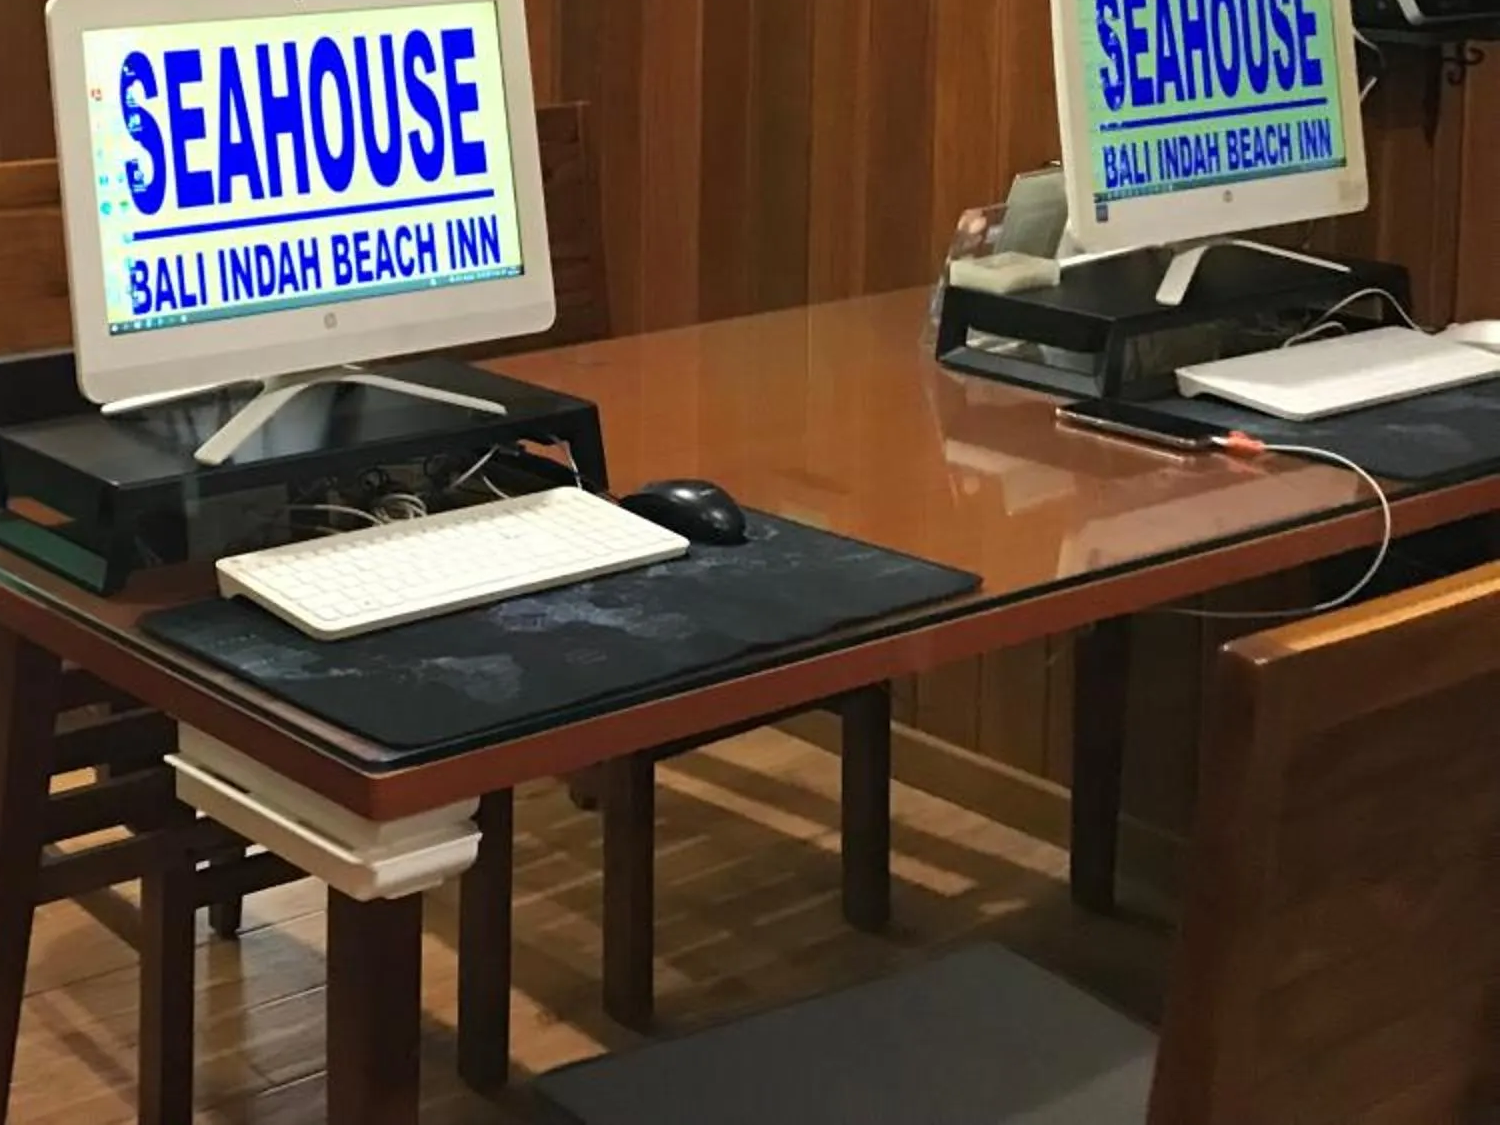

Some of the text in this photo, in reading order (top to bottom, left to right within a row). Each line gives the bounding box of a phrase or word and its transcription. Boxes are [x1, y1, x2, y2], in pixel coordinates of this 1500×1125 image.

[118, 27, 488, 216] SEAHOUSE
[1103, 118, 1333, 189] BALI INDAH BEACH INN
[129, 215, 501, 316] BALI INDAH BEACH INN
